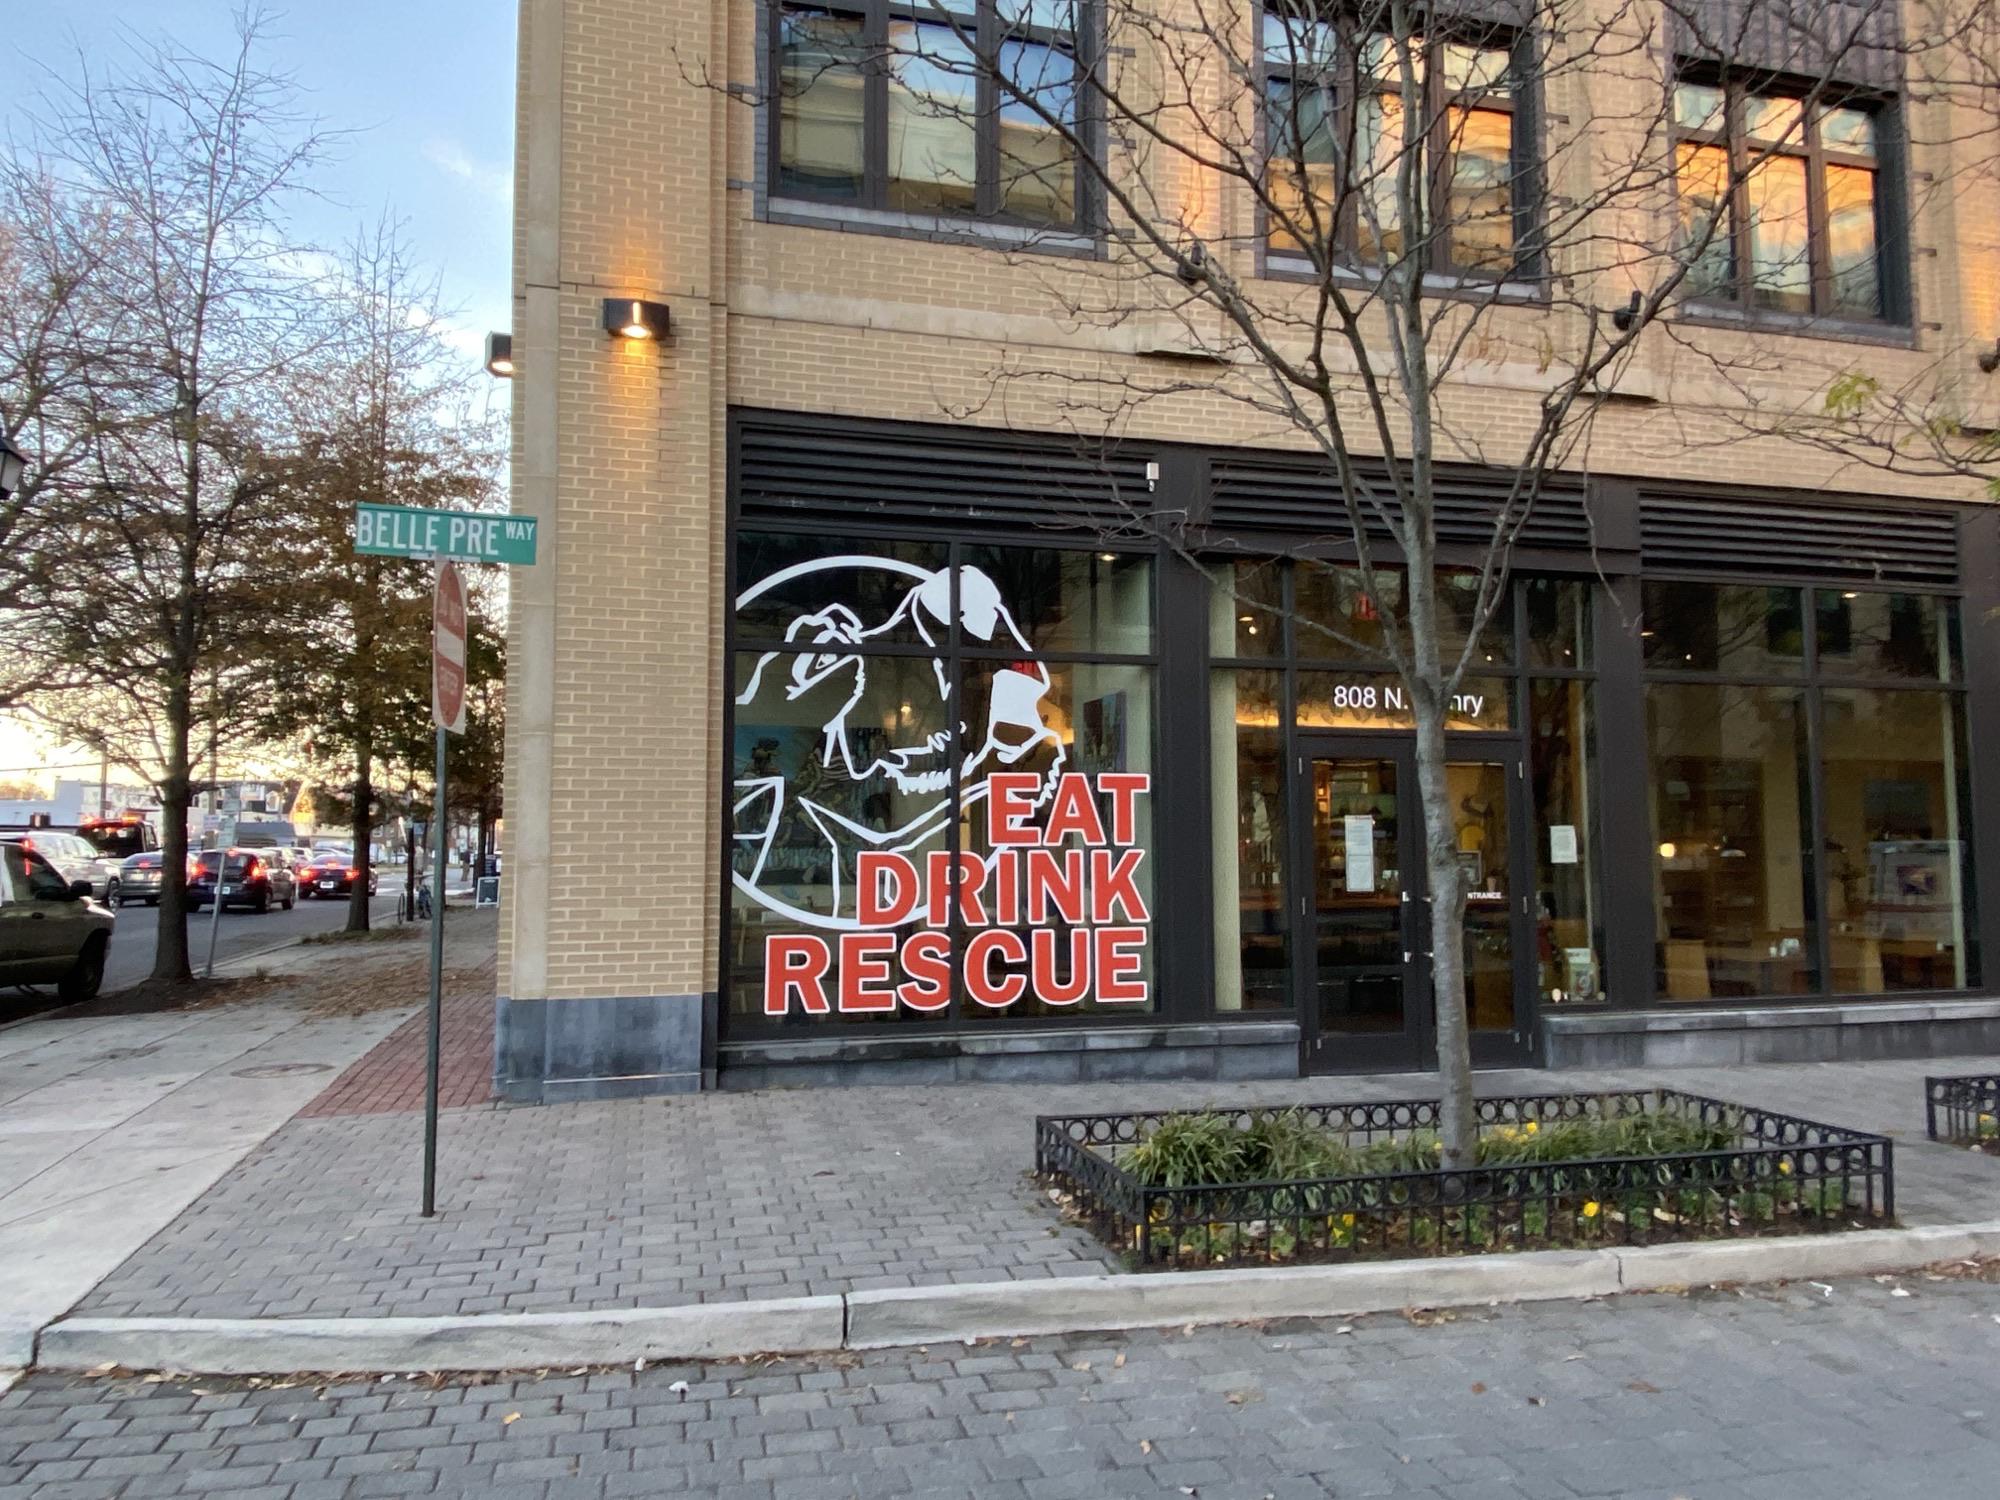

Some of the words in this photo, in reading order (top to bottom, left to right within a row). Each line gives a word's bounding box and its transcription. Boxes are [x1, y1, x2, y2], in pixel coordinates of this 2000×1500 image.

[356, 510, 441, 551] BELLE
[451, 517, 500, 556] PRE
[505, 521, 536, 541] WAY
[1333, 685, 1377, 709] 808
[1384, 687, 1409, 710] N.
[986, 772, 1151, 848] EAT
[856, 848, 1151, 929] DRINK
[764, 926, 1149, 1016] RESCUE
